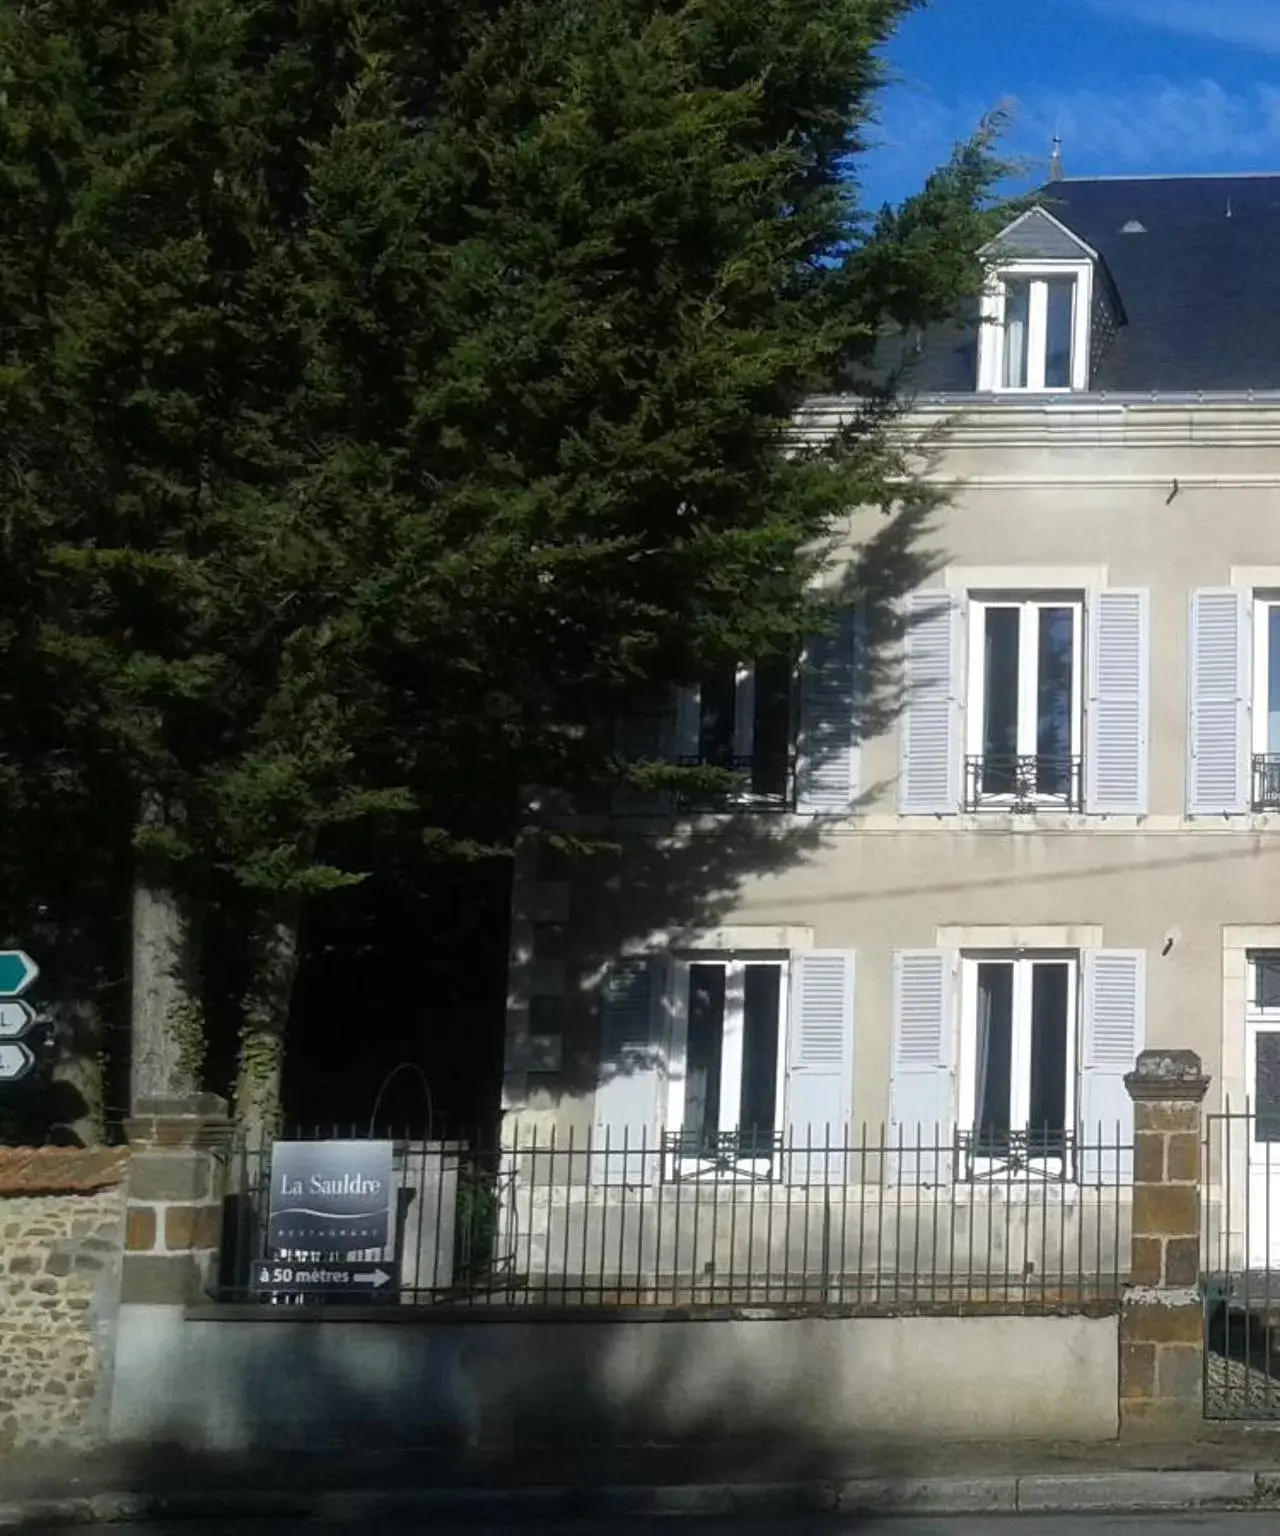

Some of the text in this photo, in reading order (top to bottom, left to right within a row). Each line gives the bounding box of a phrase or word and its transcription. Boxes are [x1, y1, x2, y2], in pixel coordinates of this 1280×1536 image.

[281, 1173, 381, 1195] La Sauldre
[260, 1267, 350, 1283] à 50 mètres
